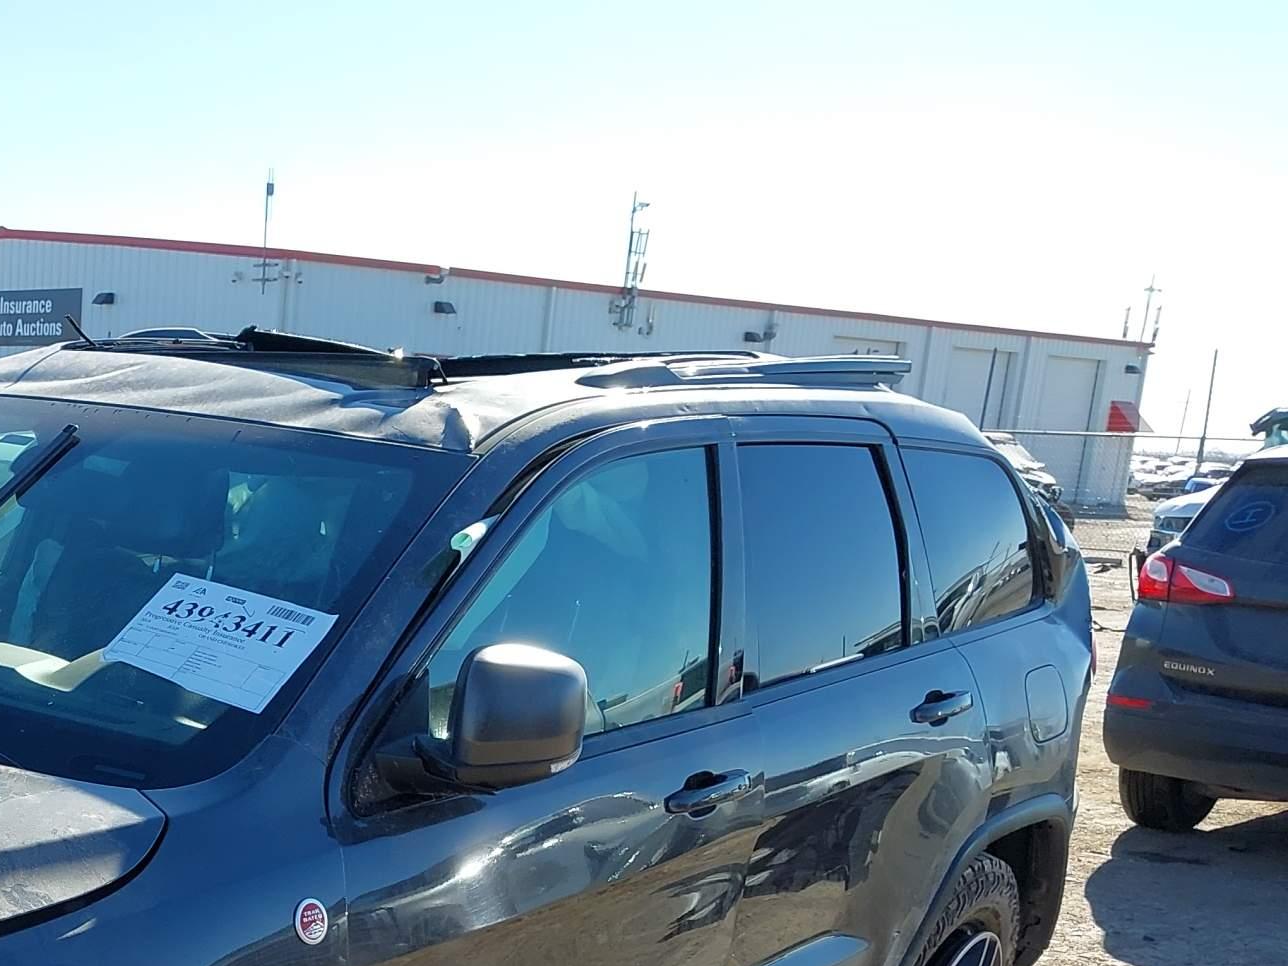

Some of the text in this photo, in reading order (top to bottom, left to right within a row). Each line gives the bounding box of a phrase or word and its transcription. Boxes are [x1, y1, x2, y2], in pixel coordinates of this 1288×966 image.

[0, 296, 53, 315] Insurance
[15, 318, 62, 337] Auctions
[162, 599, 296, 649] 43943411
[1163, 660, 1216, 676] EQUINOX
